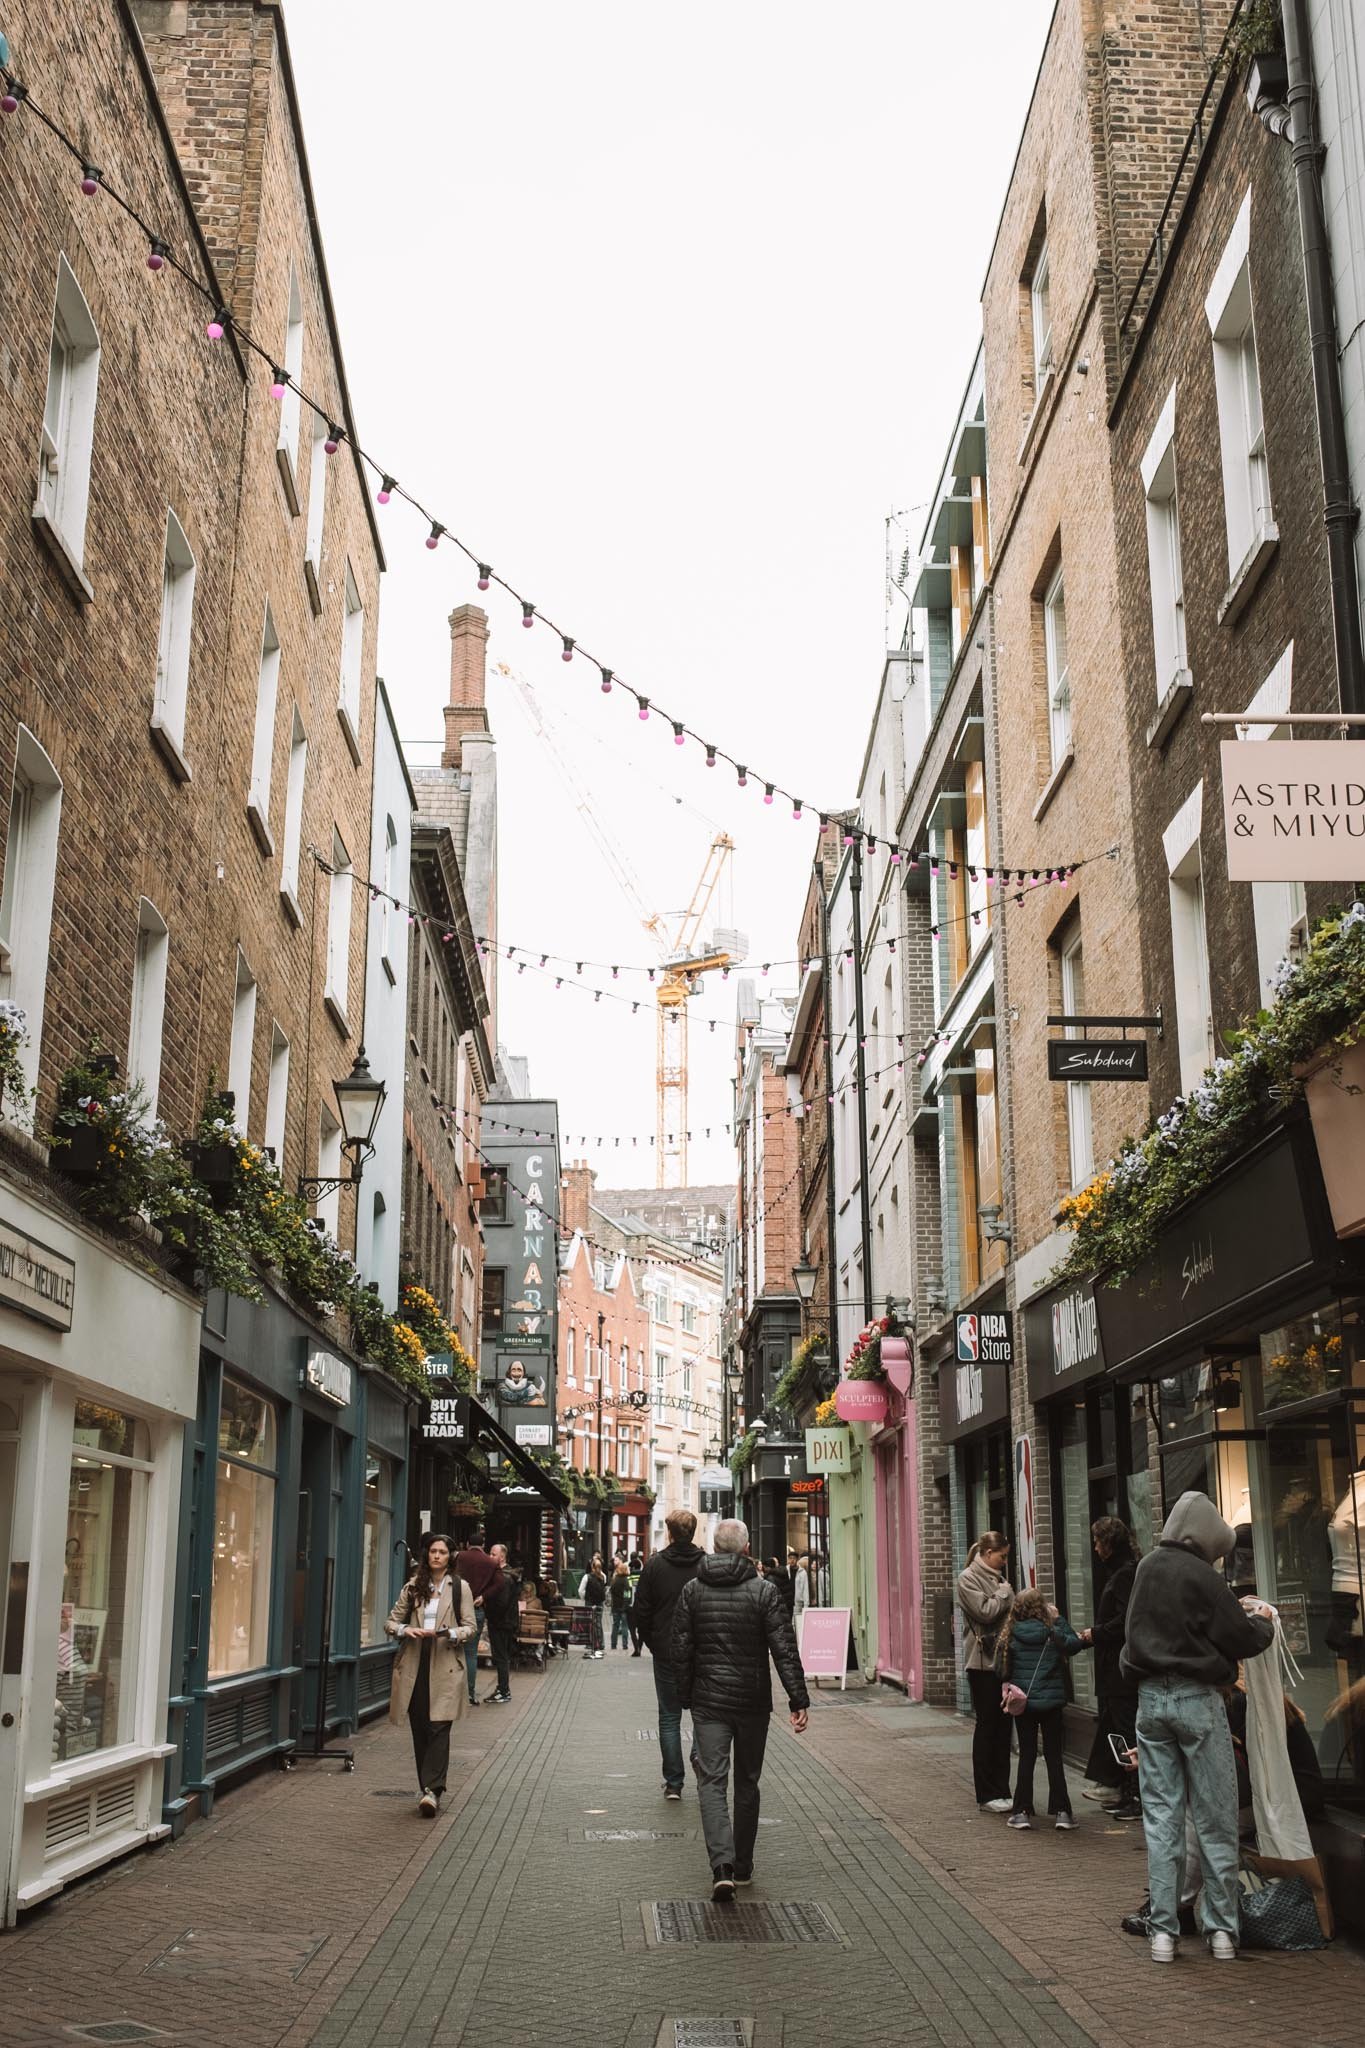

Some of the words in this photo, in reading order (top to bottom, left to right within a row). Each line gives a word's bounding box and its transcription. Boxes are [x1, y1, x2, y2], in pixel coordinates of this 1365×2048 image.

[1232, 784, 1365, 806] ASTRID
[1234, 813, 1254, 837] &
[1273, 814, 1365, 837] MIYU
[1059, 1048, 1137, 1071] Subdued
[34, 1261, 71, 1310] MELVILLE
[981, 1315, 1007, 1338] NBA
[1059, 1294, 1078, 1371] NBA
[1077, 1290, 1098, 1363] Store
[981, 1338, 1011, 1361] Store
[430, 1399, 458, 1411] BUY
[839, 1394, 884, 1403] SCULPTED
[429, 1412, 458, 1425] SELL
[422, 1425, 464, 1438] TRADE
[791, 1479, 823, 1493] size?
